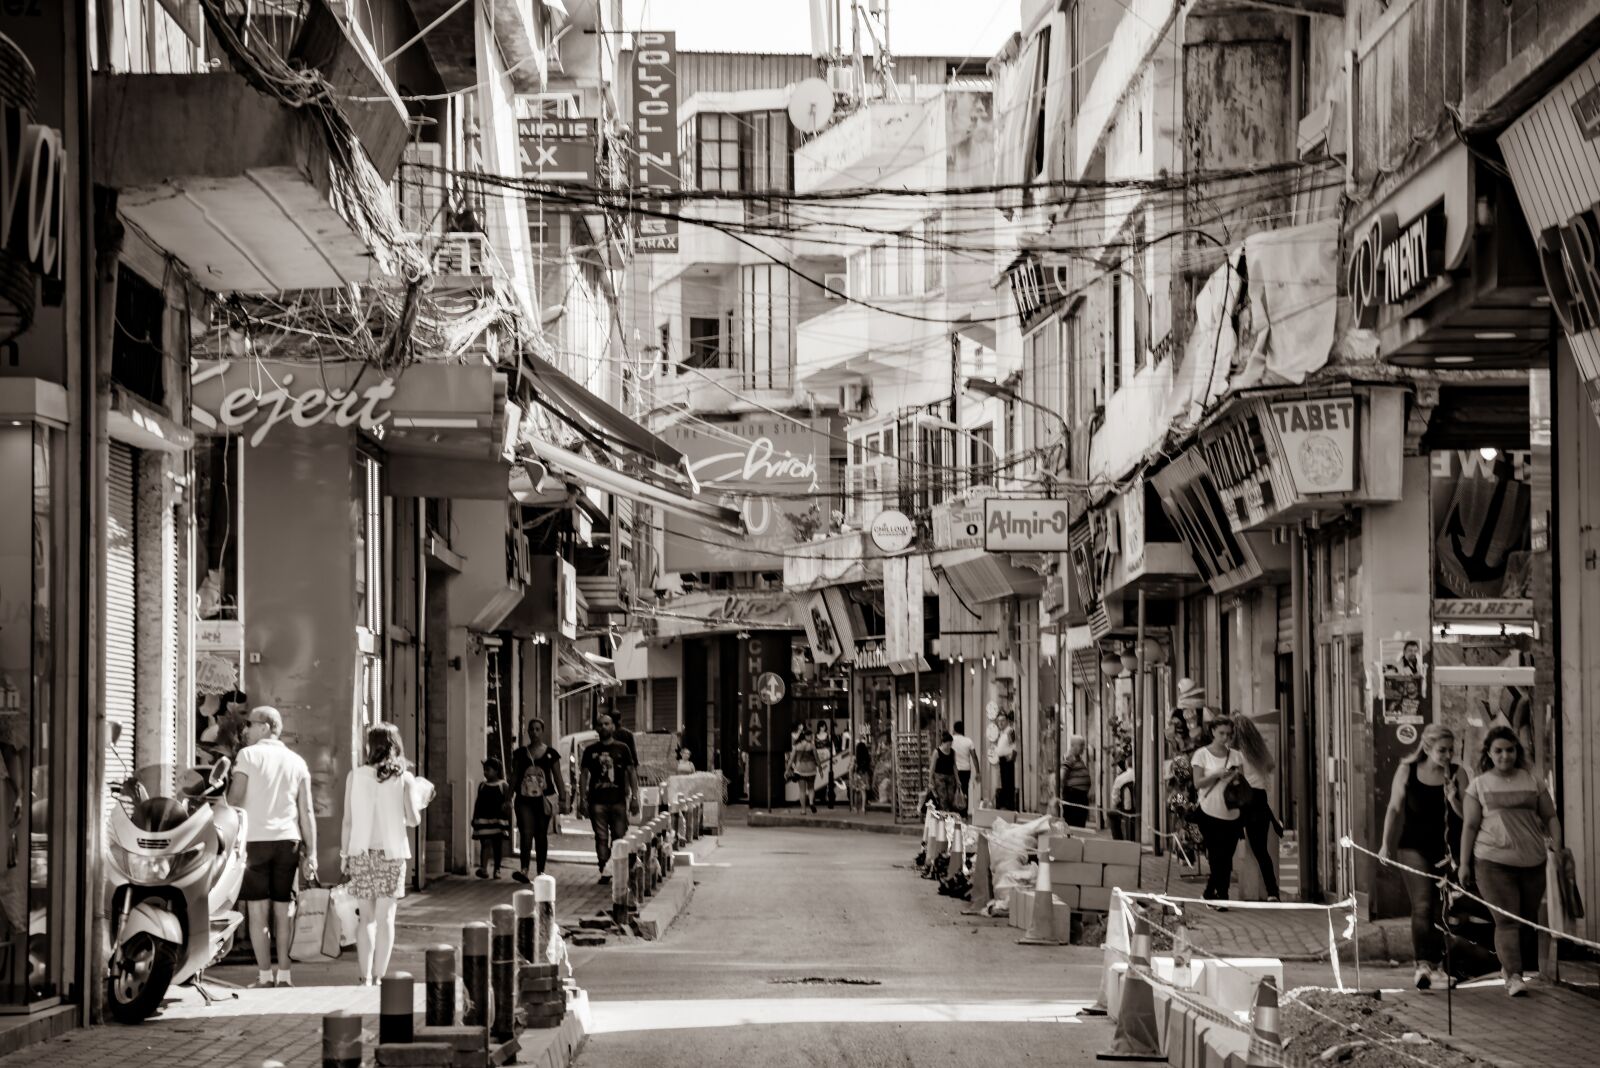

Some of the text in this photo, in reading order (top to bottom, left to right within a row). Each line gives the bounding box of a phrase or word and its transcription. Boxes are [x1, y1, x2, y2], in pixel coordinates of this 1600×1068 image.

[1383, 213, 1428, 305] TWENTY
[1273, 402, 1353, 433] TABET
[748, 639, 763, 747] CHIRAK
